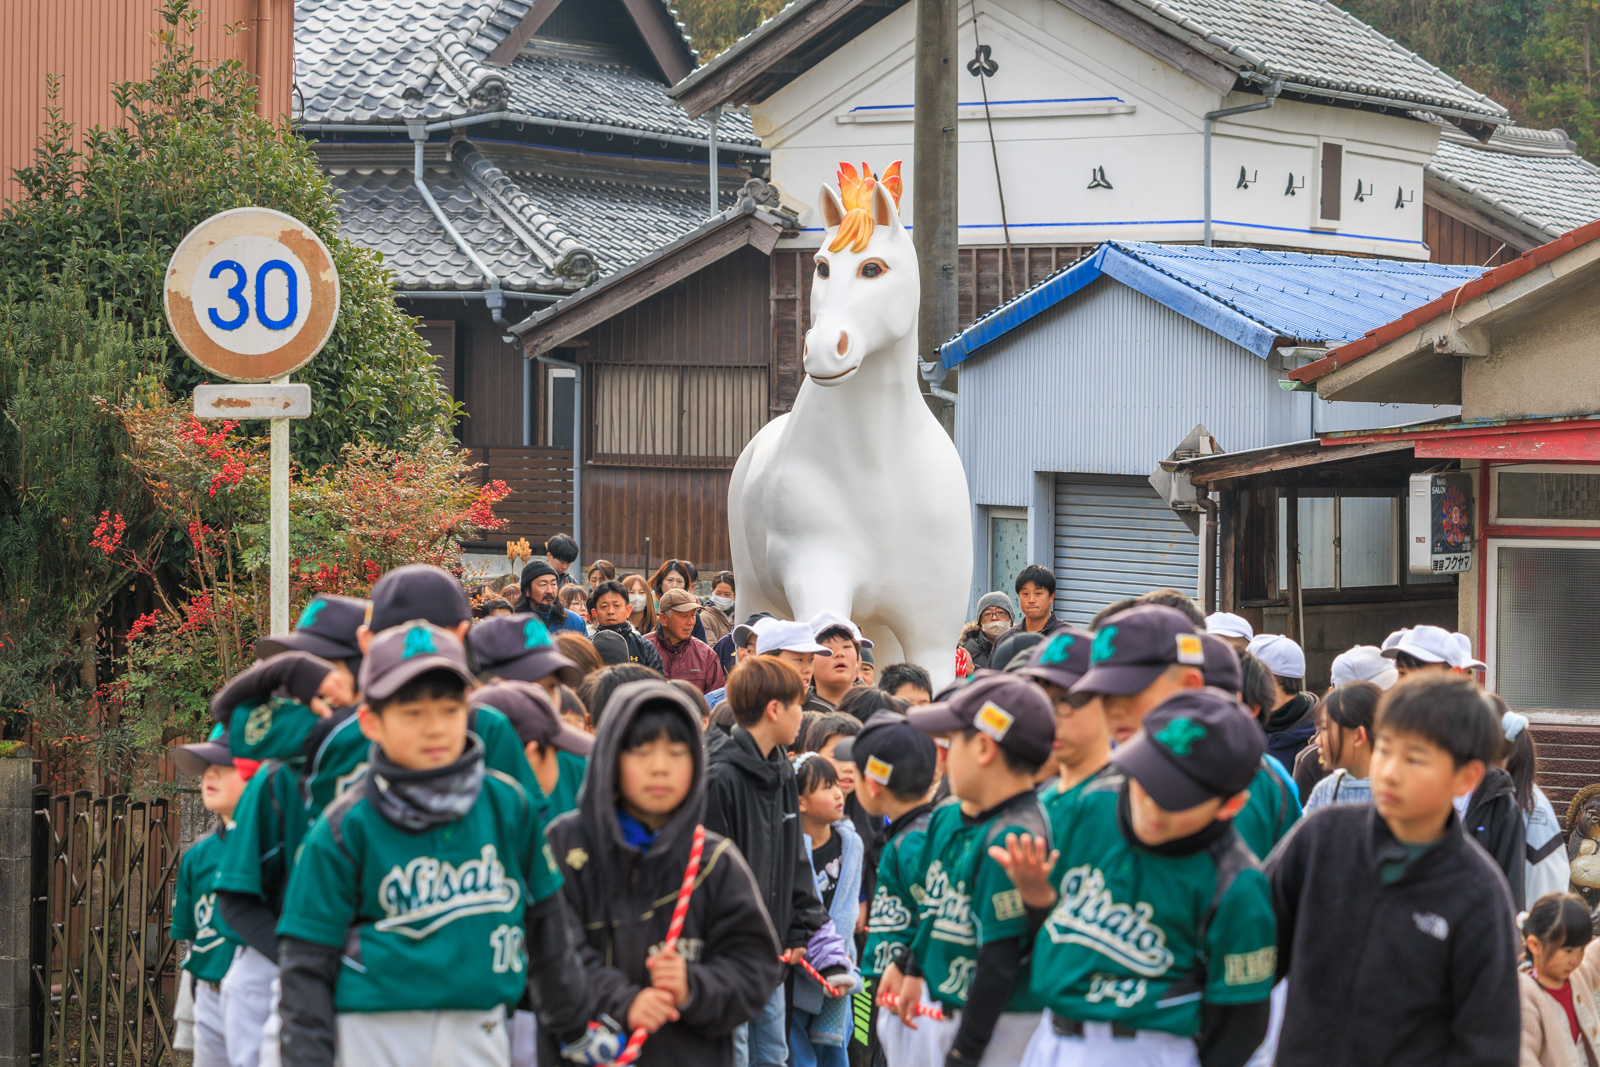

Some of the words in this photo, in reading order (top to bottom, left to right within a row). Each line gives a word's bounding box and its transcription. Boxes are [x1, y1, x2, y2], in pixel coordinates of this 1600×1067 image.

[208, 260, 298, 331] 30
[1433, 555, 1470, 571] 理容フクヤマ
